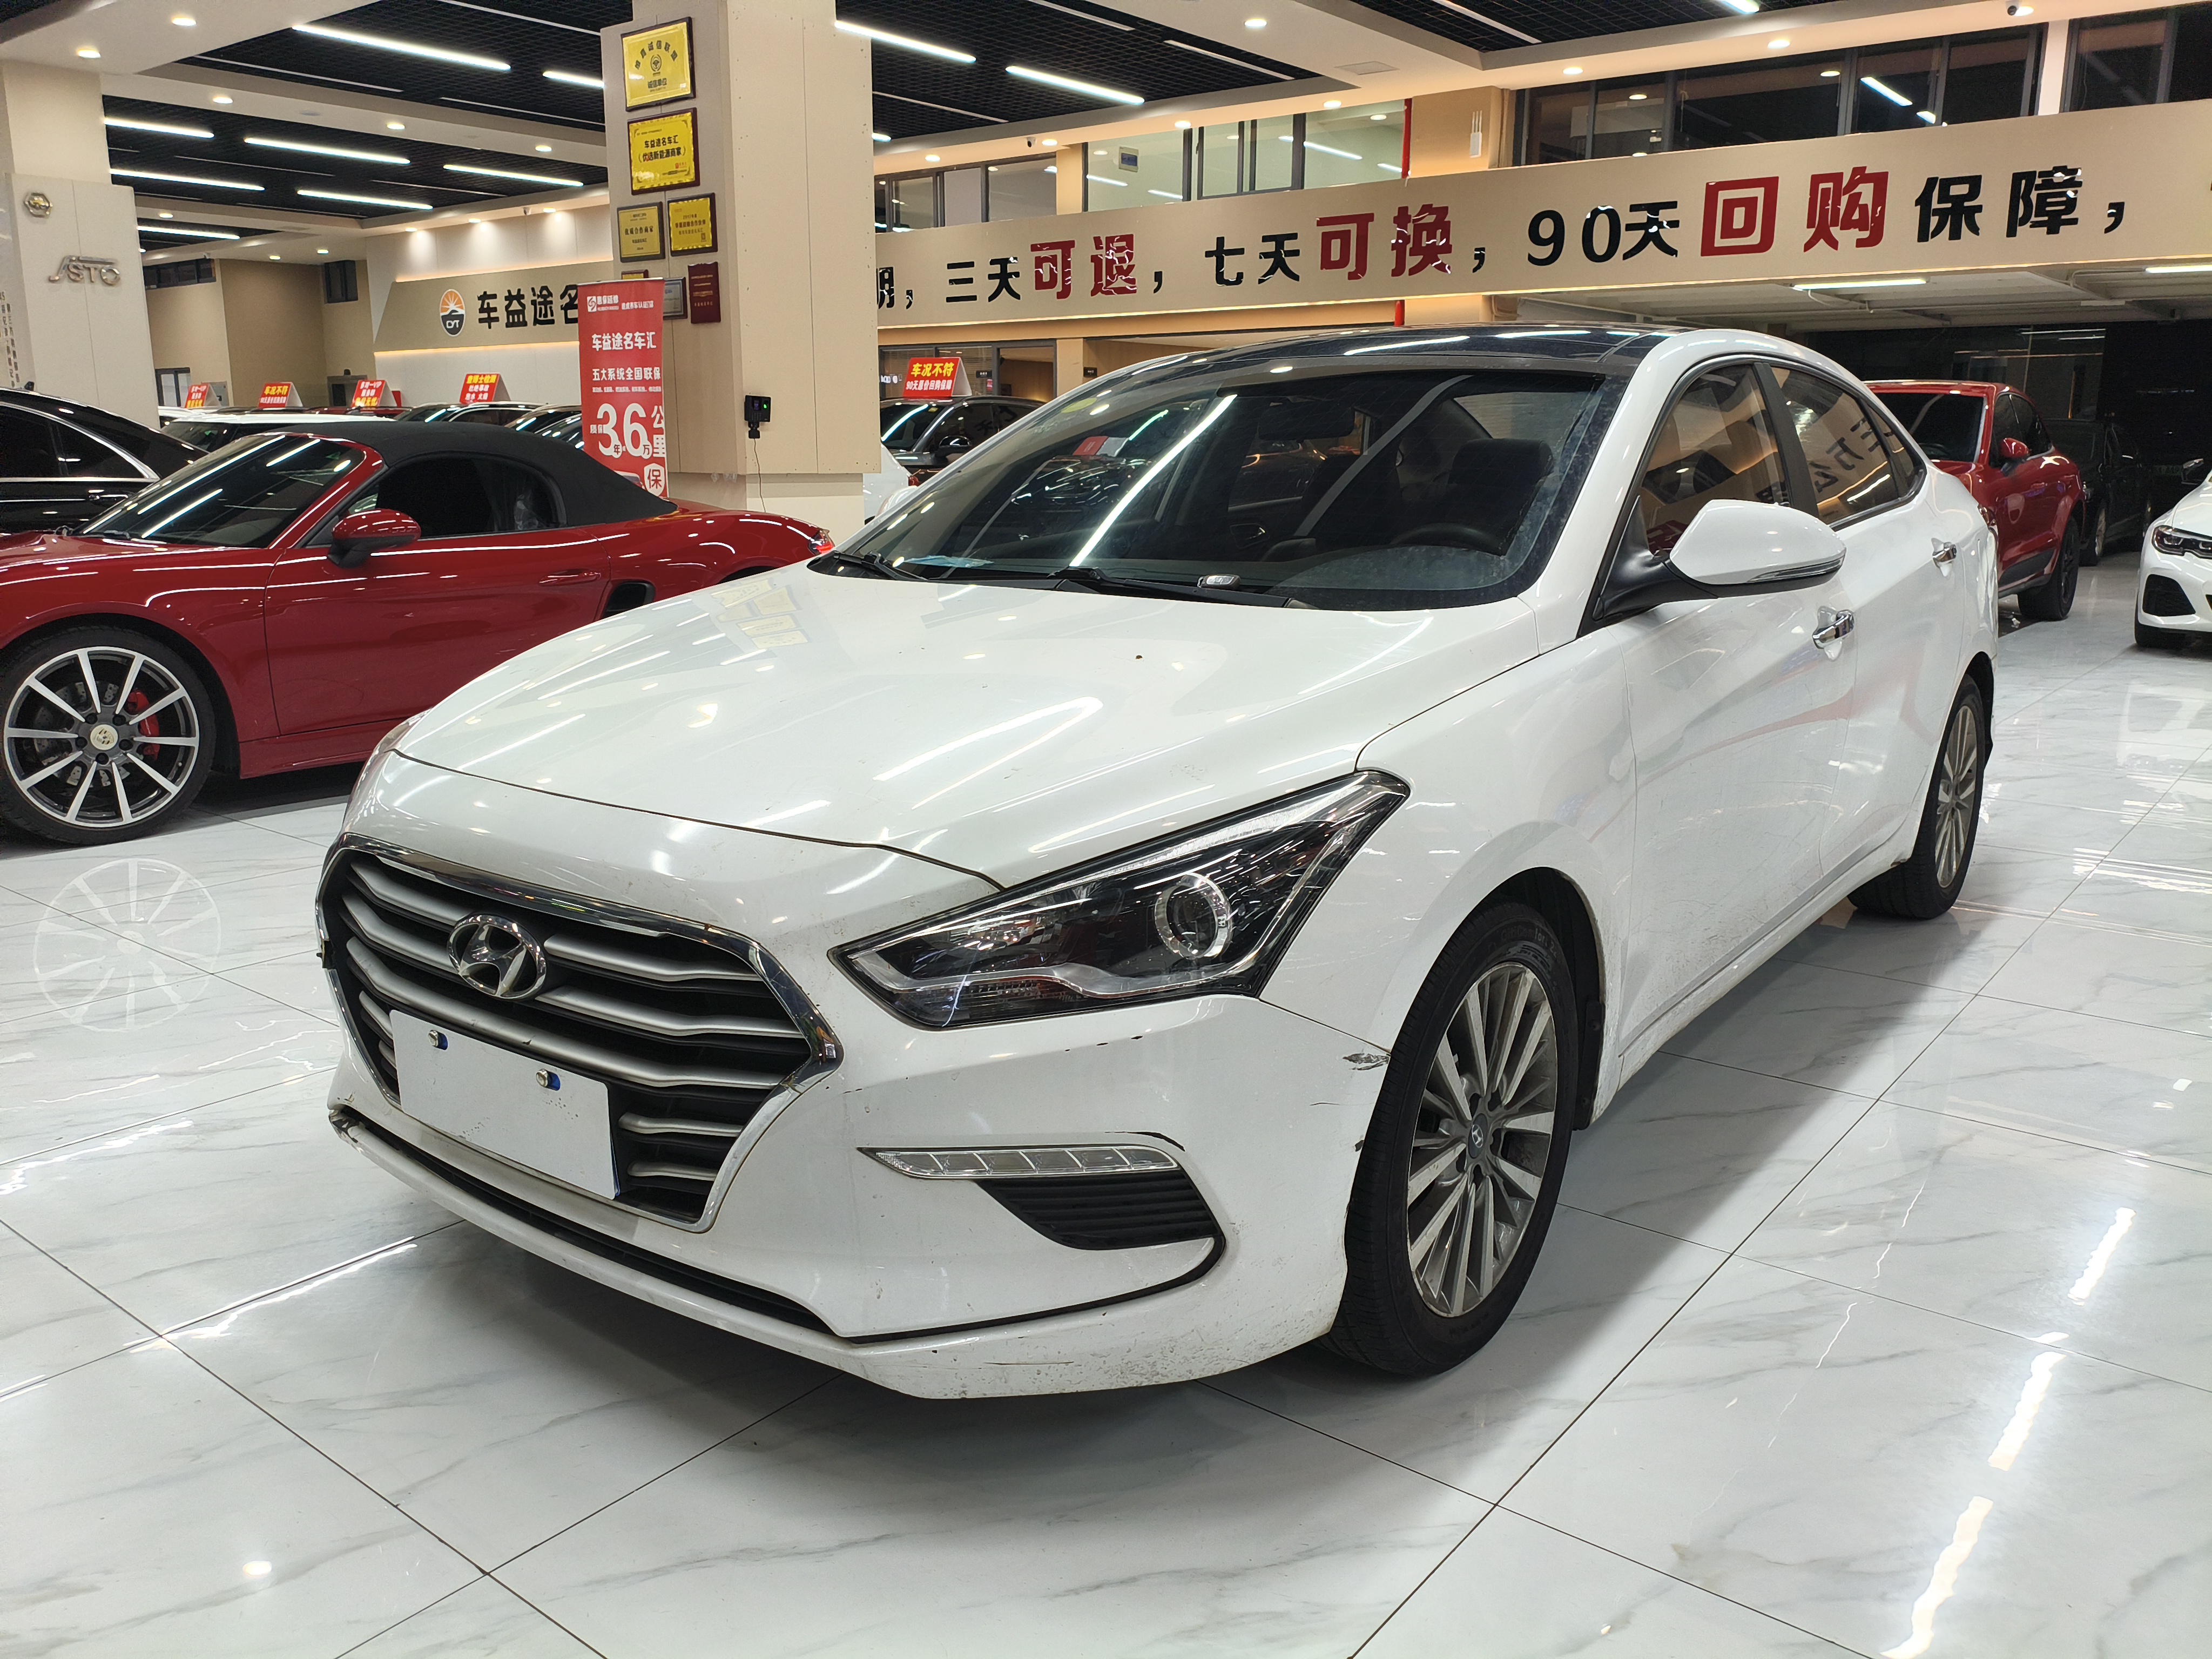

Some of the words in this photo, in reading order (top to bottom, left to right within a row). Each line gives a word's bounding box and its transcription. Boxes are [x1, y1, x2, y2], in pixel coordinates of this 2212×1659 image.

[477, 285, 578, 329] 车益途名
[592, 331, 657, 352] 车益途名车汇
[592, 367, 661, 381] 五大系统全国联保
[911, 362, 955, 377] 车况不符
[647, 469, 662, 489] 保
